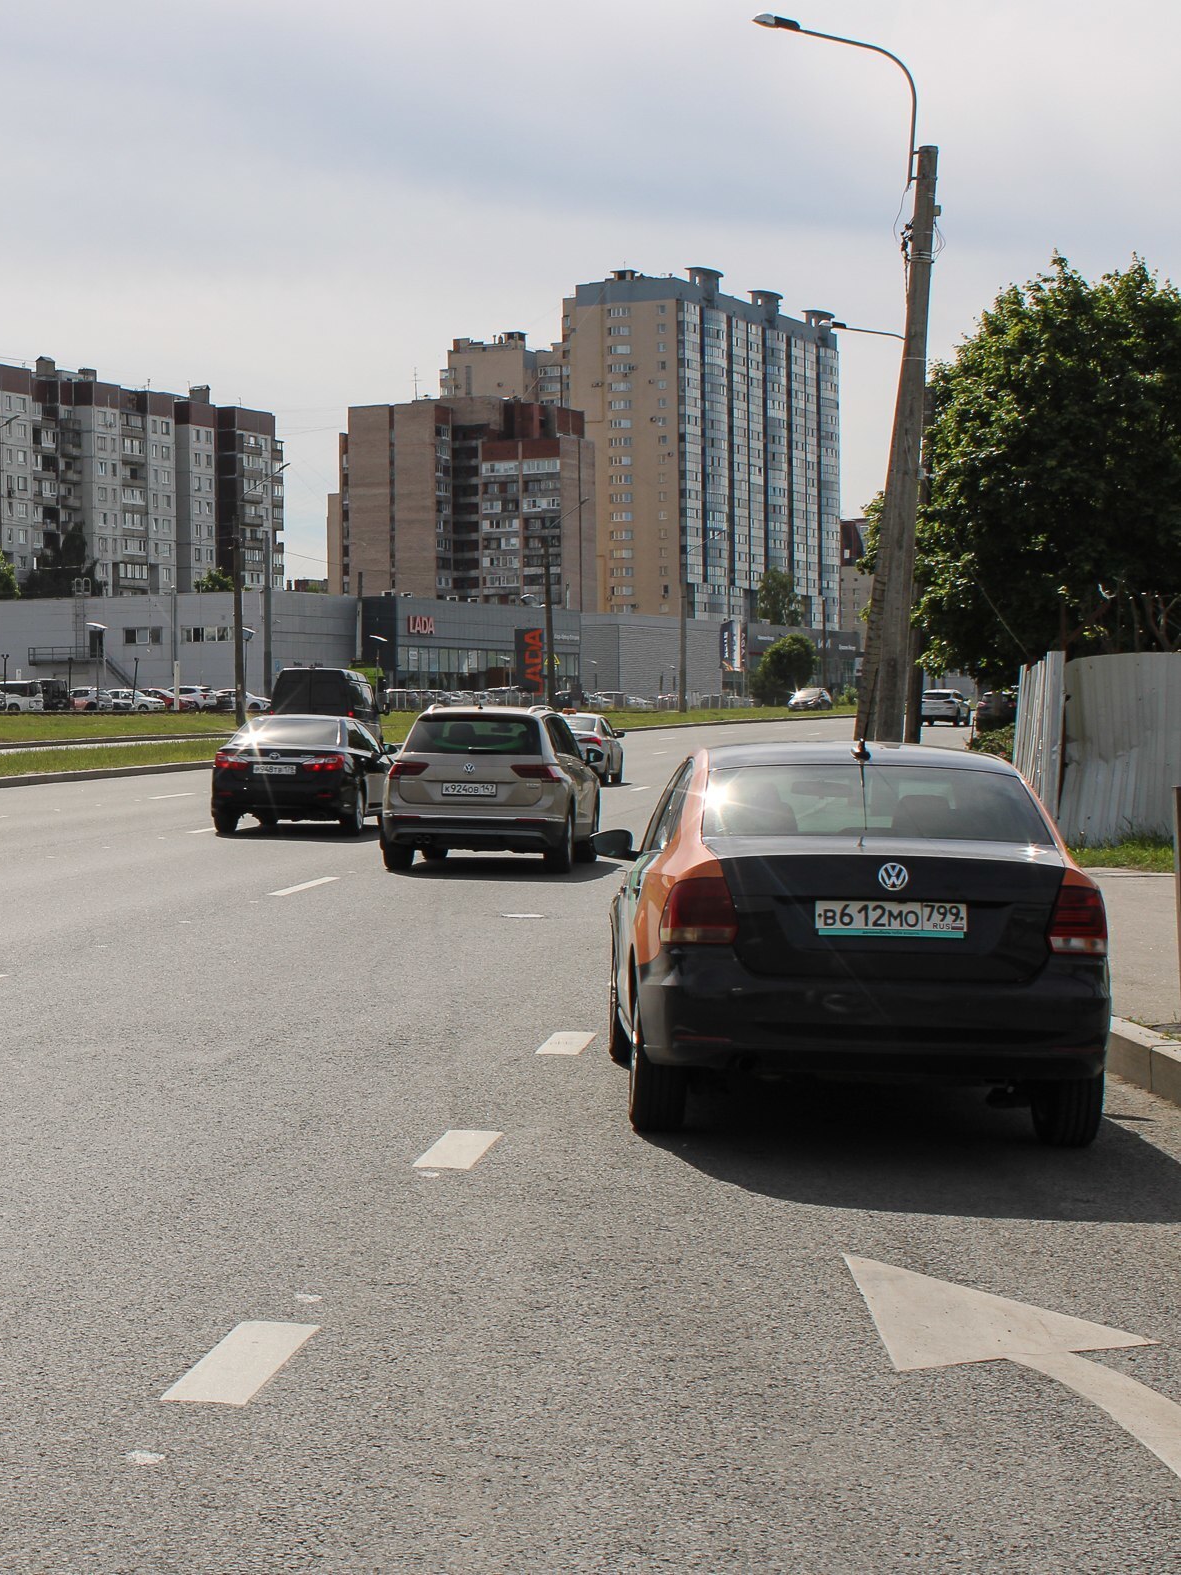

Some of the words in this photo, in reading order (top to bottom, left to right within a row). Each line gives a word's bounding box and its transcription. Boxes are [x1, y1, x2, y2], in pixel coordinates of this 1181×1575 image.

[408, 615, 435, 635] LADA
[524, 628, 543, 696] LADA
[823, 903, 919, 928] В612МО
[924, 903, 960, 923] 799
[933, 922, 950, 931] RUS
